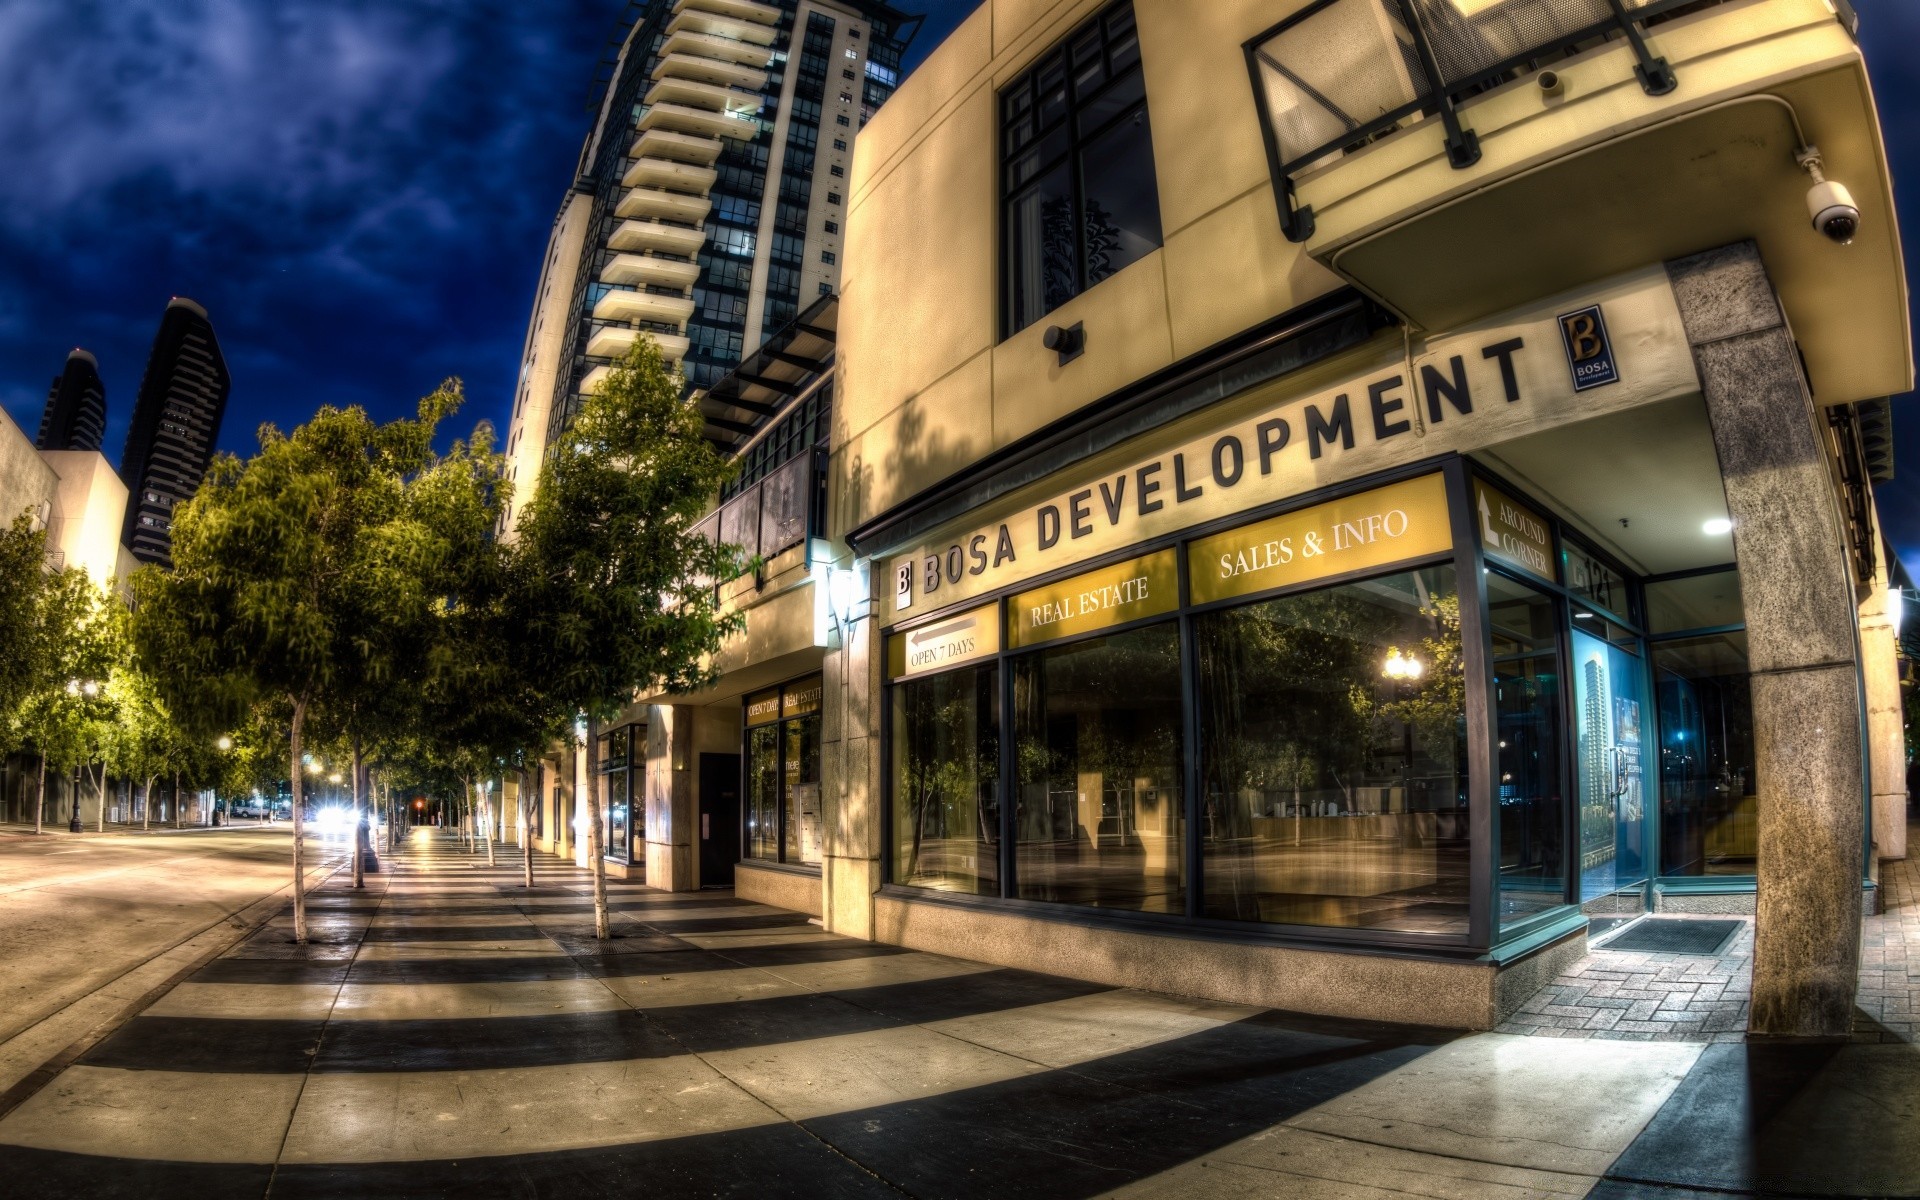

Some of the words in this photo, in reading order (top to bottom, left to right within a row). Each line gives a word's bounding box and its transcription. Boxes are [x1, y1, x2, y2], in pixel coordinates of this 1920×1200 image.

[1577, 361, 1609, 376] BOSA
[1579, 370, 1610, 382] Development
[924, 524, 1016, 594] BOSA
[1037, 336, 1524, 551] DEVELOPMENT
[1220, 537, 1293, 579] SALES
[1302, 531, 1325, 558] &
[1331, 509, 1408, 551] INFO
[1500, 502, 1545, 545] AROUND
[1503, 533, 1548, 574] CORNER
[1031, 599, 1074, 628] REAL
[1079, 576, 1149, 616] ESTATE
[1584, 557, 1612, 610] 121
[911, 647, 937, 667] OPEN
[939, 647, 946, 662] 7
[948, 637, 975, 658] DAYS
[748, 703, 762, 717] OPEN
[785, 693, 799, 707] REAL
[800, 687, 822, 704] ESTATE
